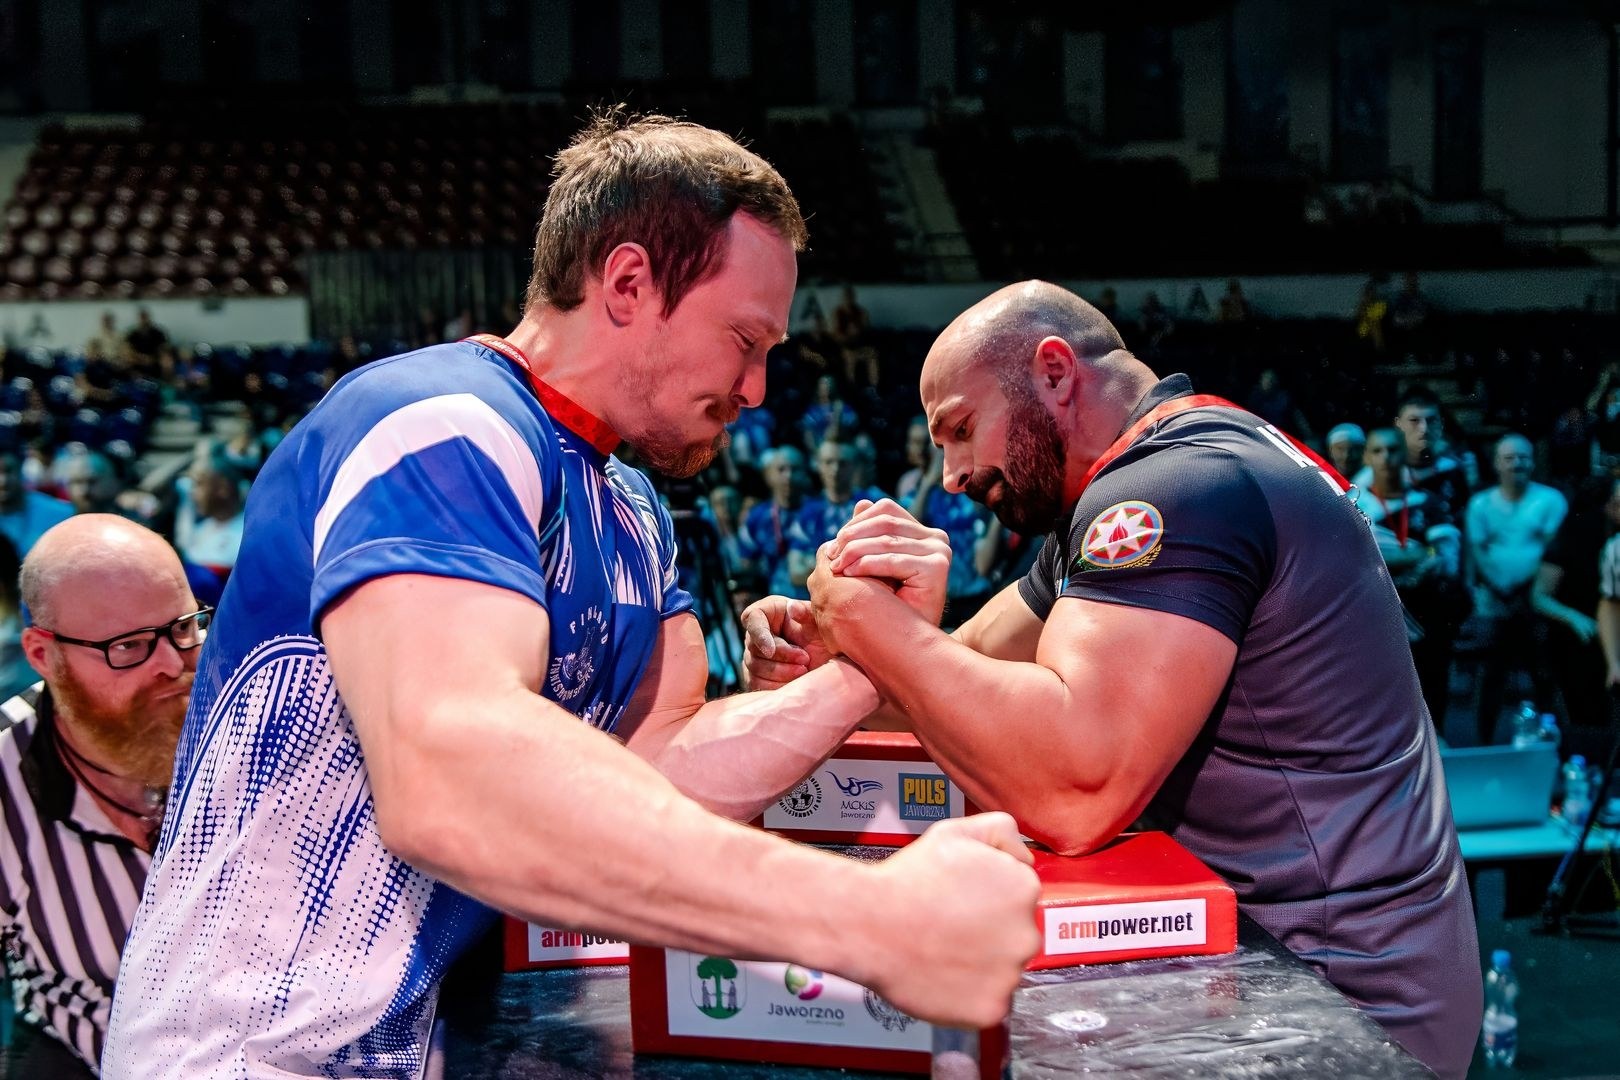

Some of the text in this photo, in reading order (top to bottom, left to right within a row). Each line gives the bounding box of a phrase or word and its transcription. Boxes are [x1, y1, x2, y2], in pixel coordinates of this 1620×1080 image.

[570, 605, 609, 644] FINLAND
[904, 778, 946, 805] PULS
[840, 800, 875, 811] MCKiS
[840, 810, 876, 819] Jaworzno
[1058, 912, 1193, 940] armpower.net
[767, 1002, 845, 1020] Jaworzno
